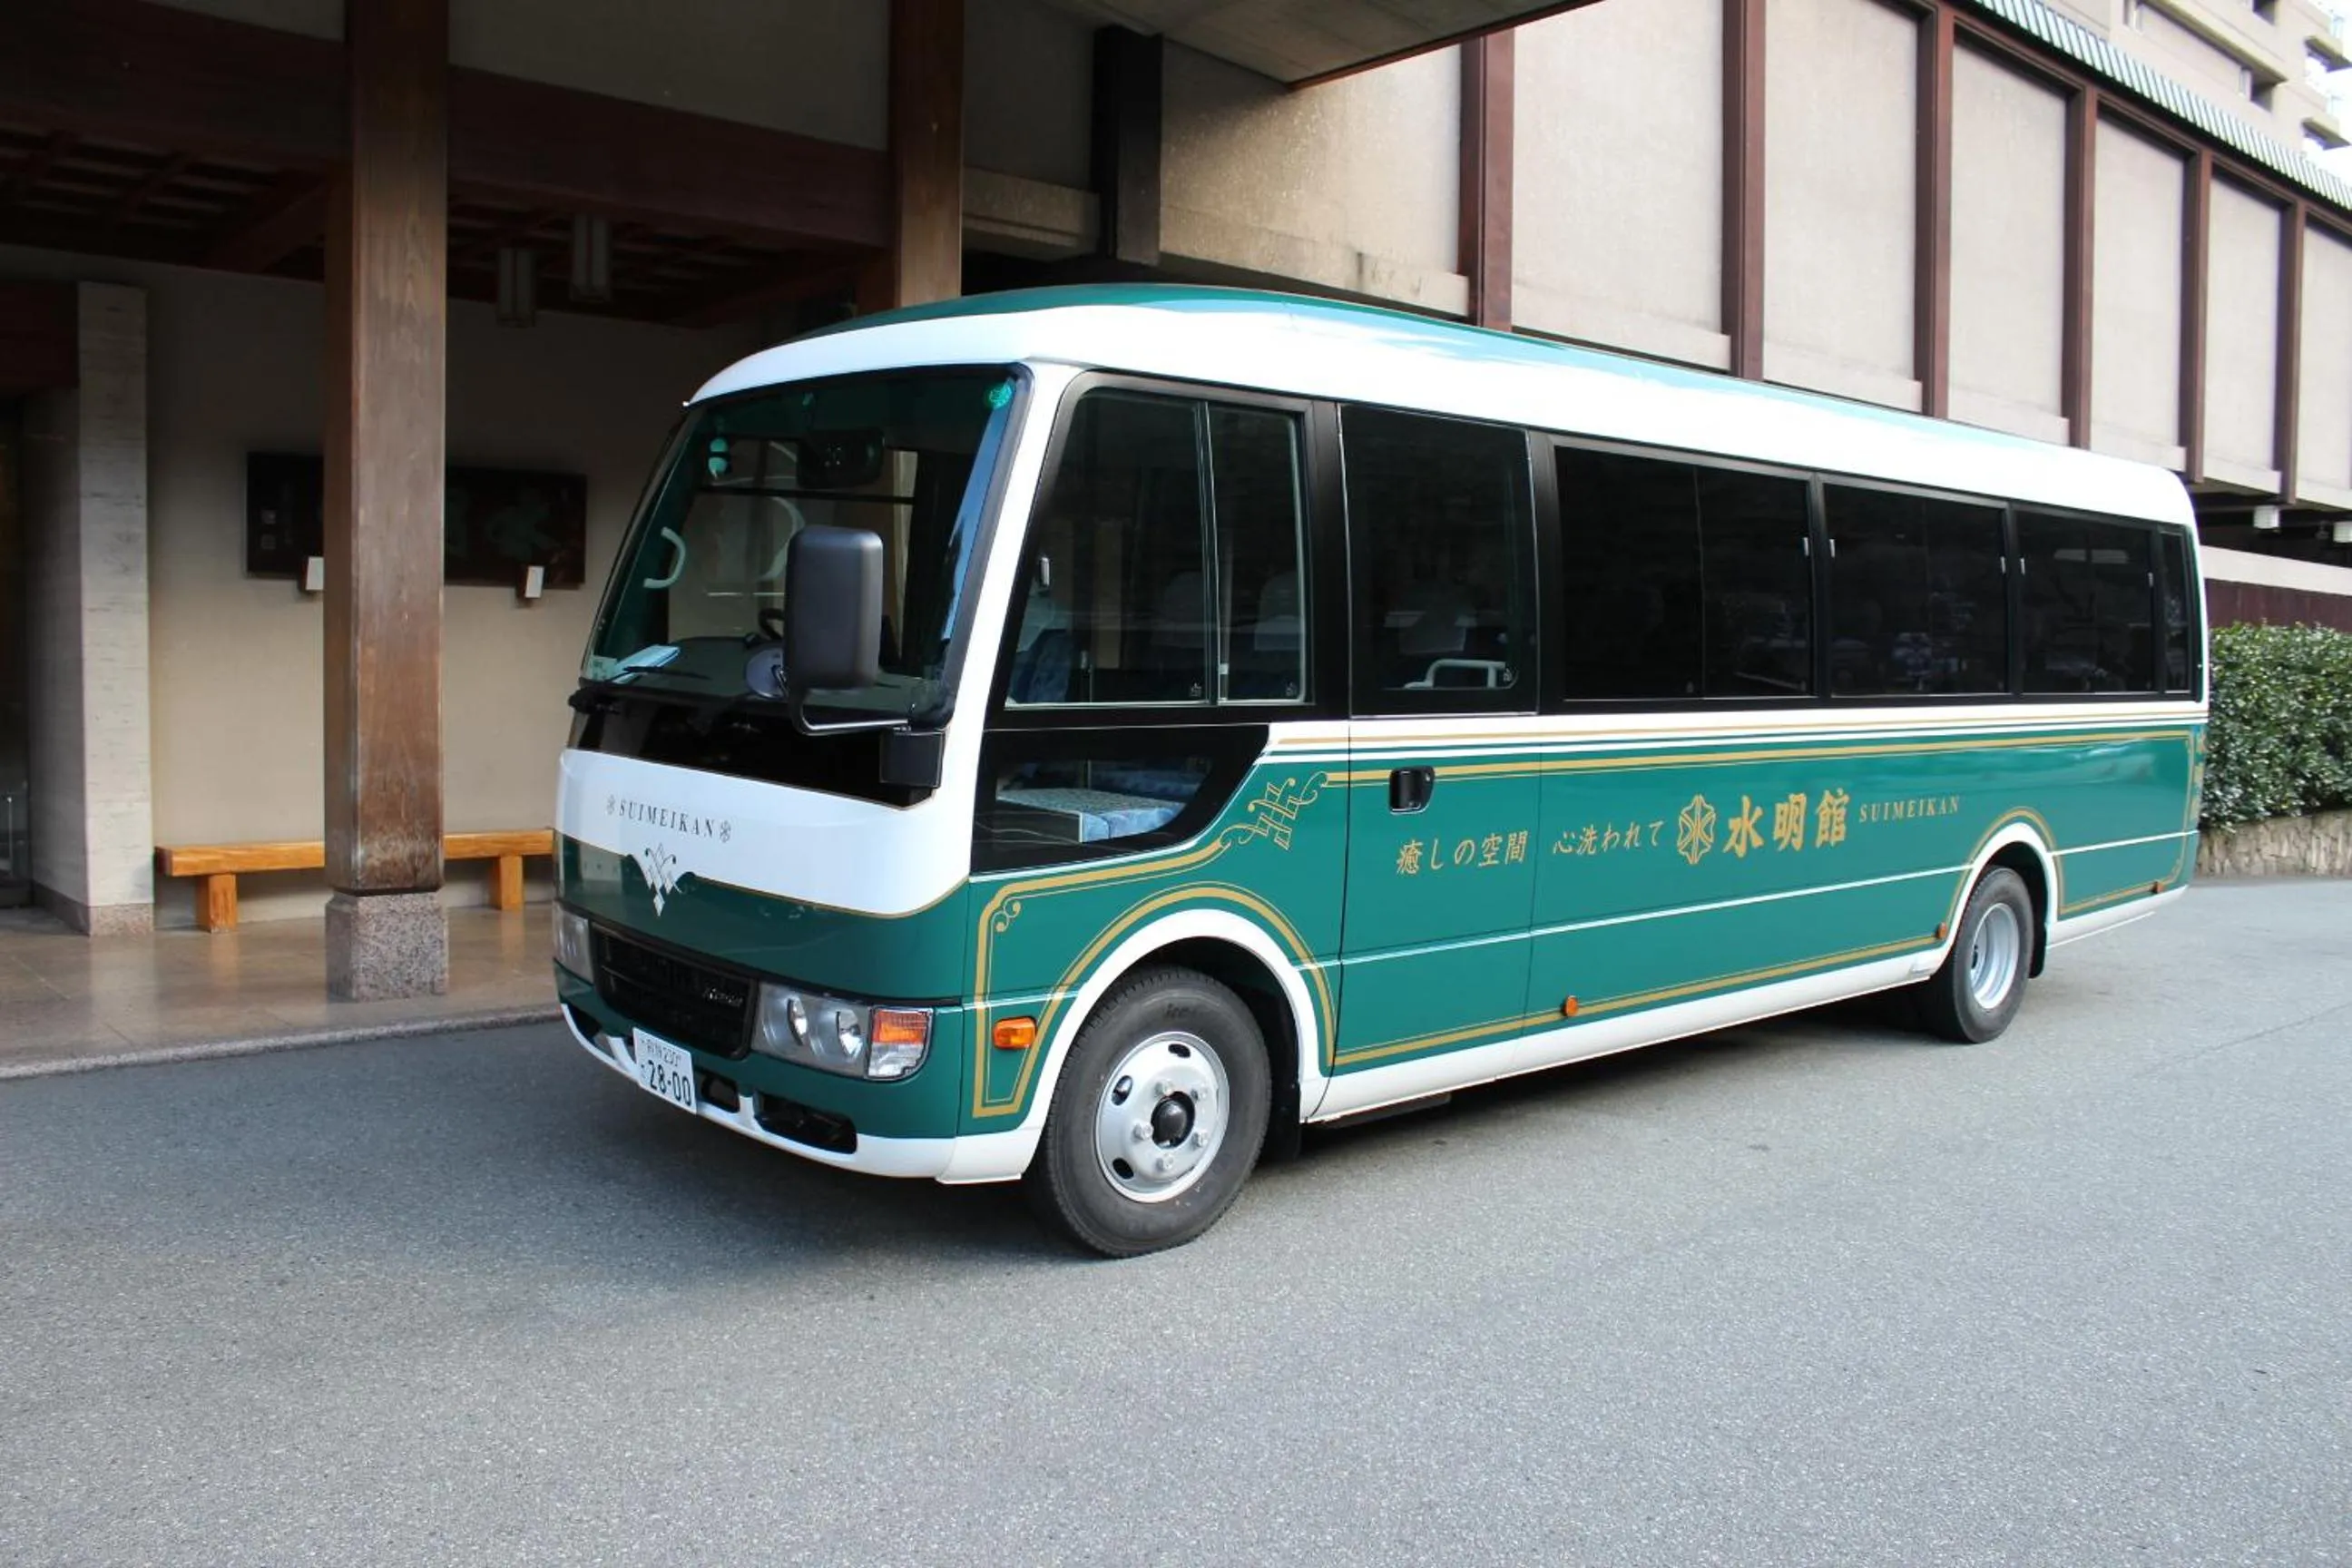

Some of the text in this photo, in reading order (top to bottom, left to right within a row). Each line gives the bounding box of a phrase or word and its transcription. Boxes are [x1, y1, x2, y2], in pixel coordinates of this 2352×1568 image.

[619, 799, 714, 838] SUIMEIKAN
[1722, 787, 1850, 858] 水明館
[1858, 796, 1960, 823] SUIMEIKAN
[1396, 819, 1665, 876] 癒しの空間 心洗われて
